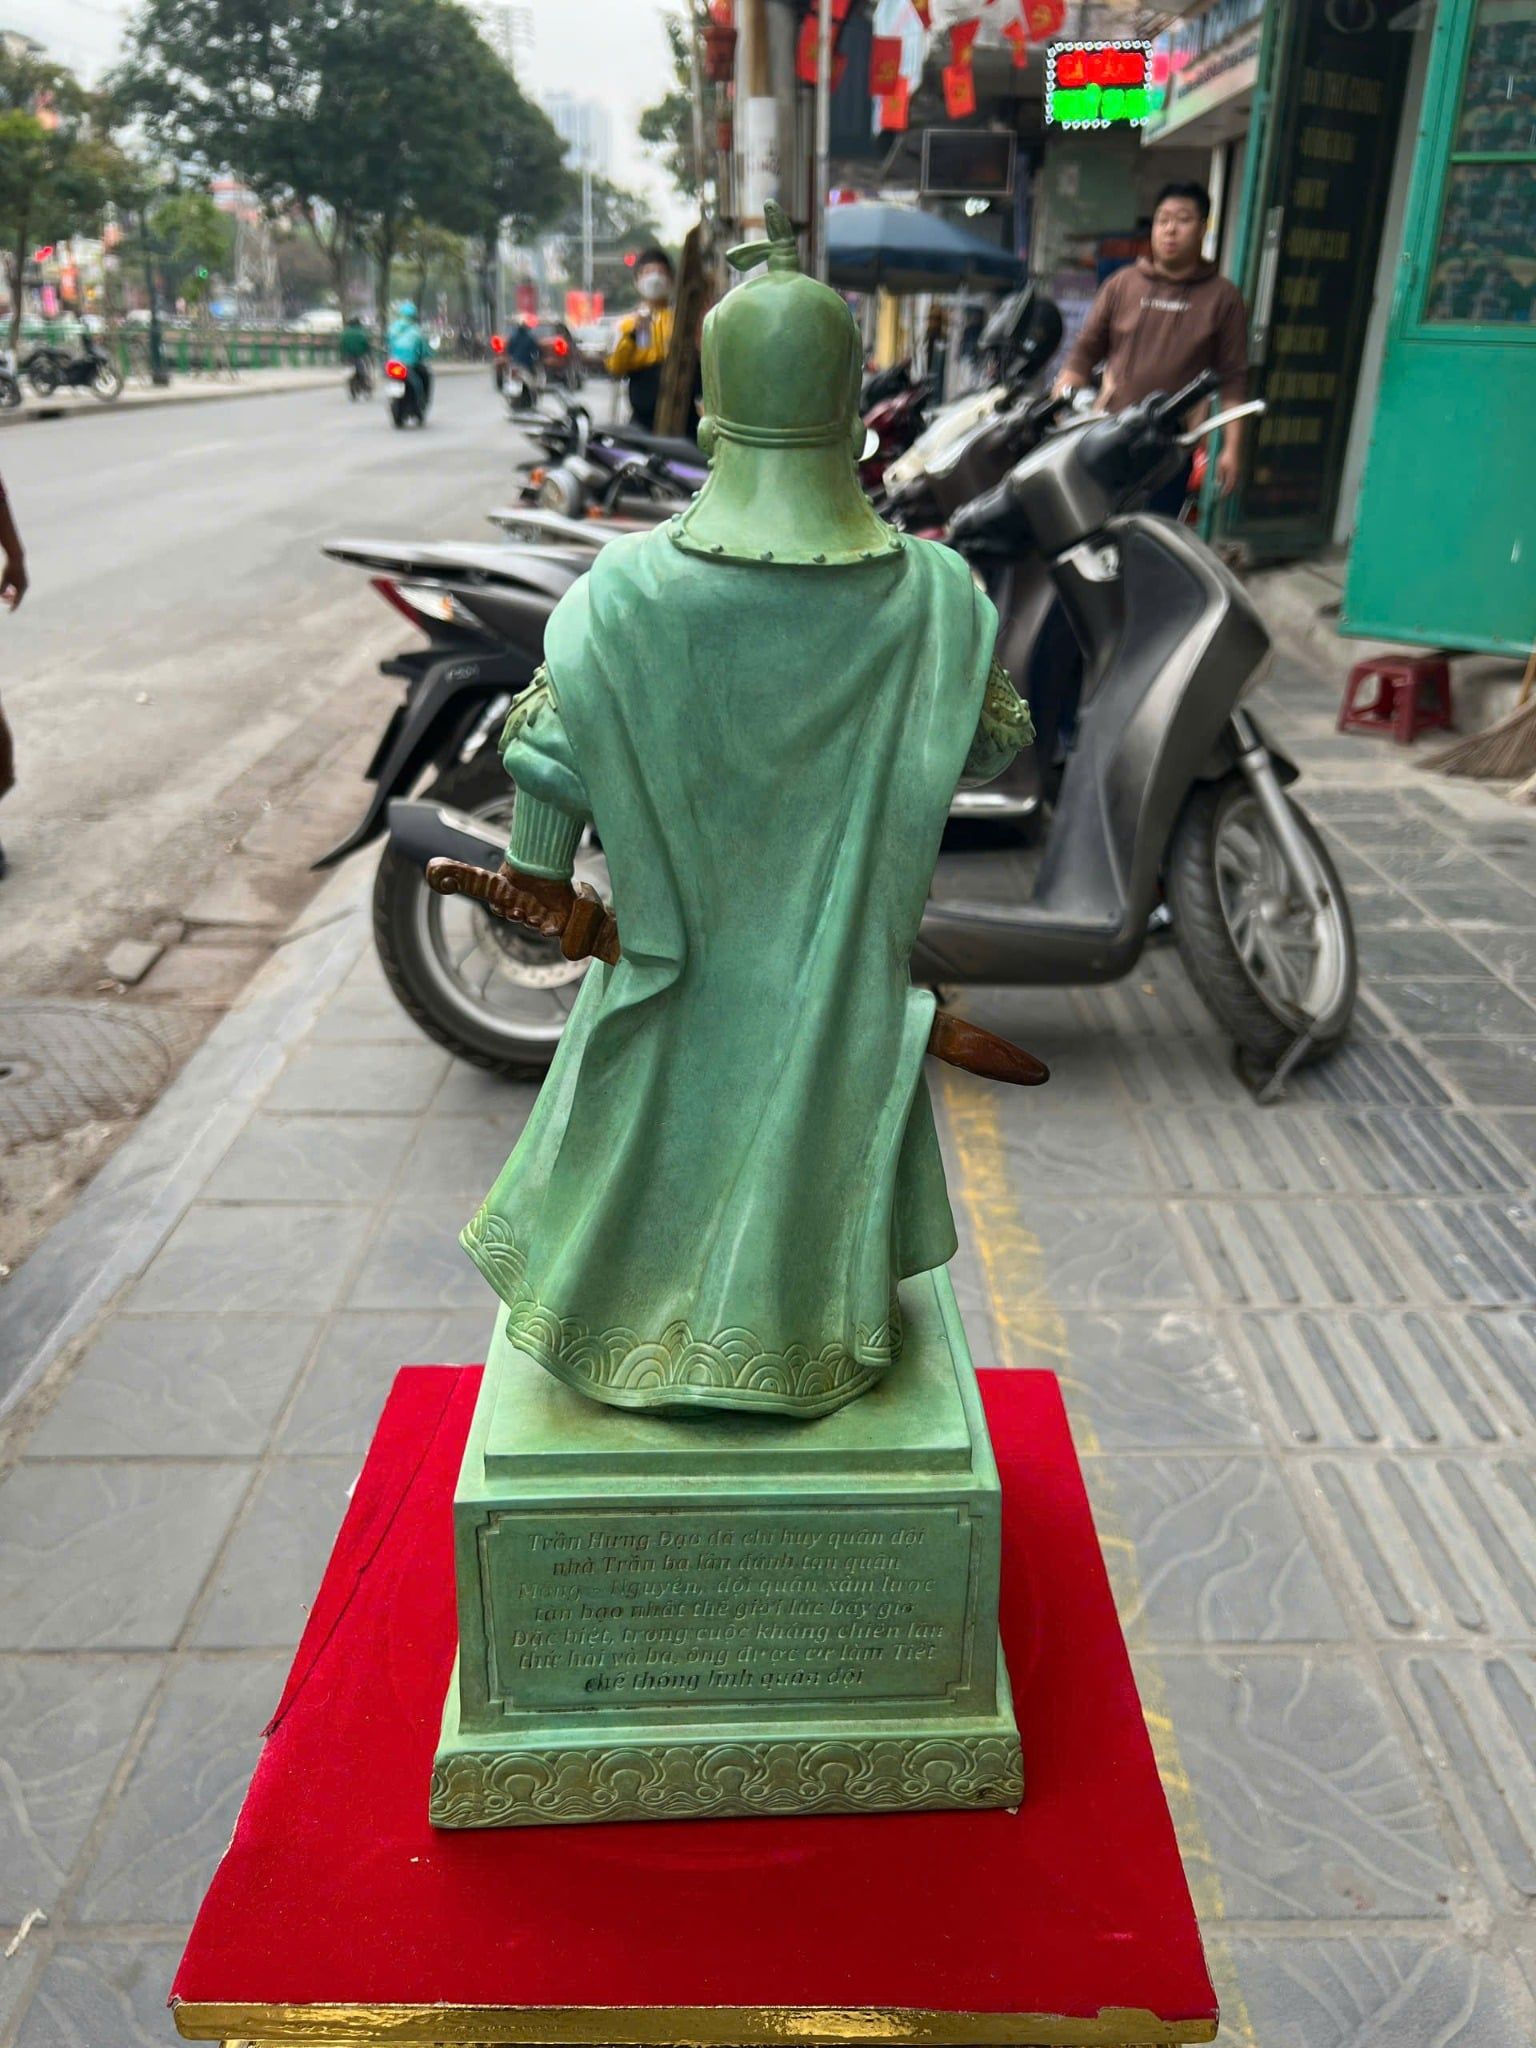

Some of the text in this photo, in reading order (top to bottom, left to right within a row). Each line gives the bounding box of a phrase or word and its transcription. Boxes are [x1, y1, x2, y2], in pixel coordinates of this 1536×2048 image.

[587, 1531, 652, 1552] Hưng
[655, 1530, 702, 1551] Đạo
[781, 1528, 823, 1550] huy
[828, 1528, 885, 1551] quân
[552, 1556, 596, 1576] nhà
[662, 1554, 690, 1572] ba
[801, 1553, 839, 1570] tan
[844, 1553, 901, 1574] quân
[758, 1575, 818, 1597] quân
[581, 1603, 624, 1624] bạo
[622, 1629, 689, 1646] trong
[756, 1623, 830, 1644] kháng
[567, 1649, 606, 1668] hai
[611, 1648, 638, 1666] và
[687, 1647, 730, 1668] ông
[839, 1644, 884, 1662] làm
[760, 1669, 821, 1691] quân
